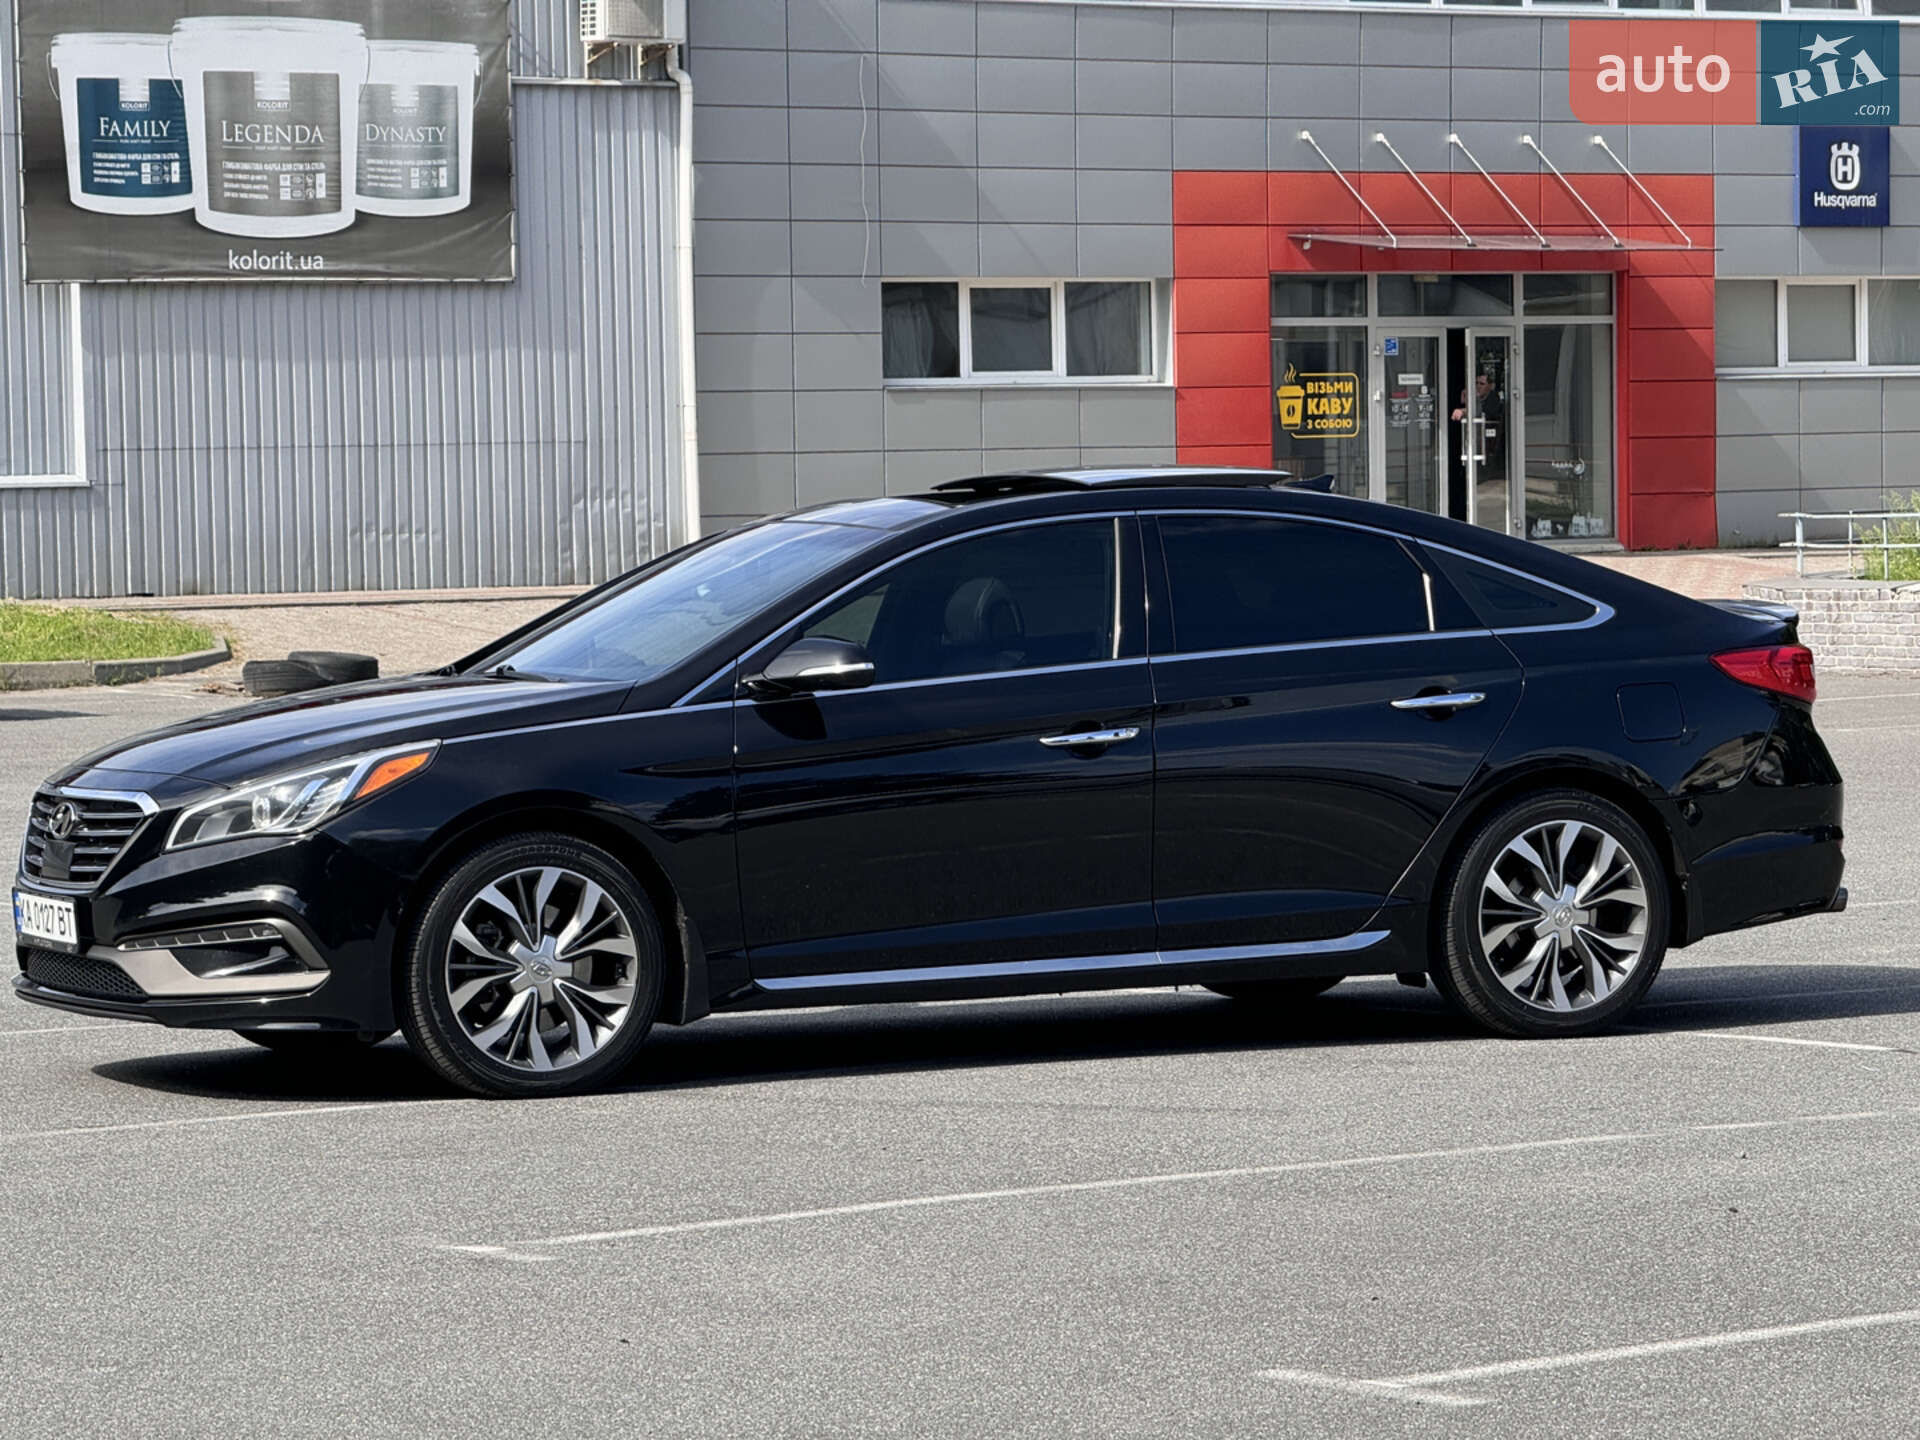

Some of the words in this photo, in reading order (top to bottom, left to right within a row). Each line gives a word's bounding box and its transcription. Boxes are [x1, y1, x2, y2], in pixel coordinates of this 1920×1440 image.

[99, 116, 171, 137] FAMILY
[221, 119, 325, 144] LEGENDA
[365, 122, 447, 143] DYNASTY
[1813, 191, 1877, 209] Husqvarna
[228, 249, 323, 270] kolorit.ua
[1306, 381, 1353, 394] ВІЗЬМИ
[1307, 397, 1353, 415] КАВУ
[1314, 418, 1353, 430] СОБОЮ
[33, 901, 55, 936] 0127
[57, 905, 73, 937] BT
